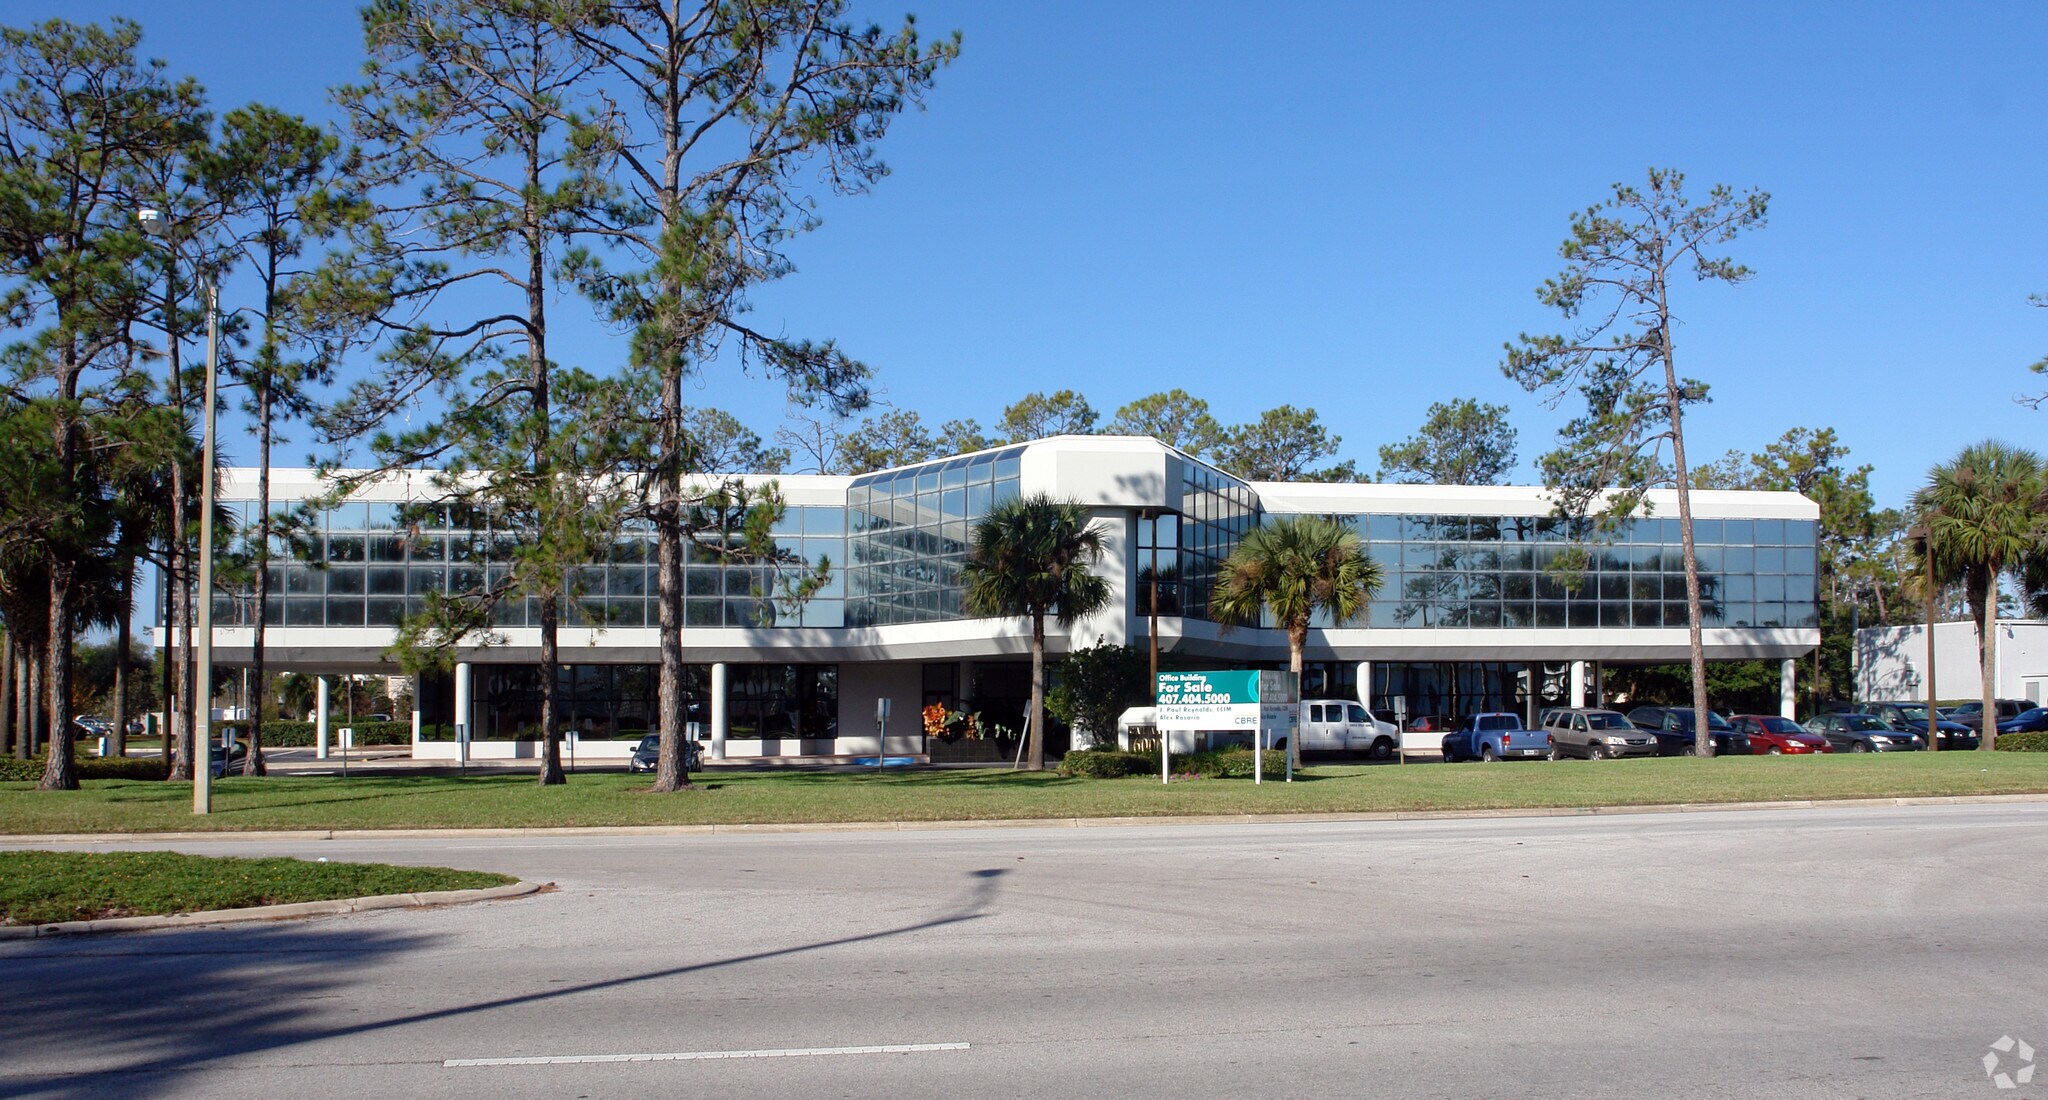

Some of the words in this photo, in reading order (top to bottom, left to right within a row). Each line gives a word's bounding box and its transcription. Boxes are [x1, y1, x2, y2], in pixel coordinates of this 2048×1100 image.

[1159, 674, 1179, 682] Office
[1180, 673, 1206, 682] Building
[1159, 682, 1181, 692] For
[1184, 681, 1213, 692] Sale
[1159, 693, 1231, 704] 407.404.5000
